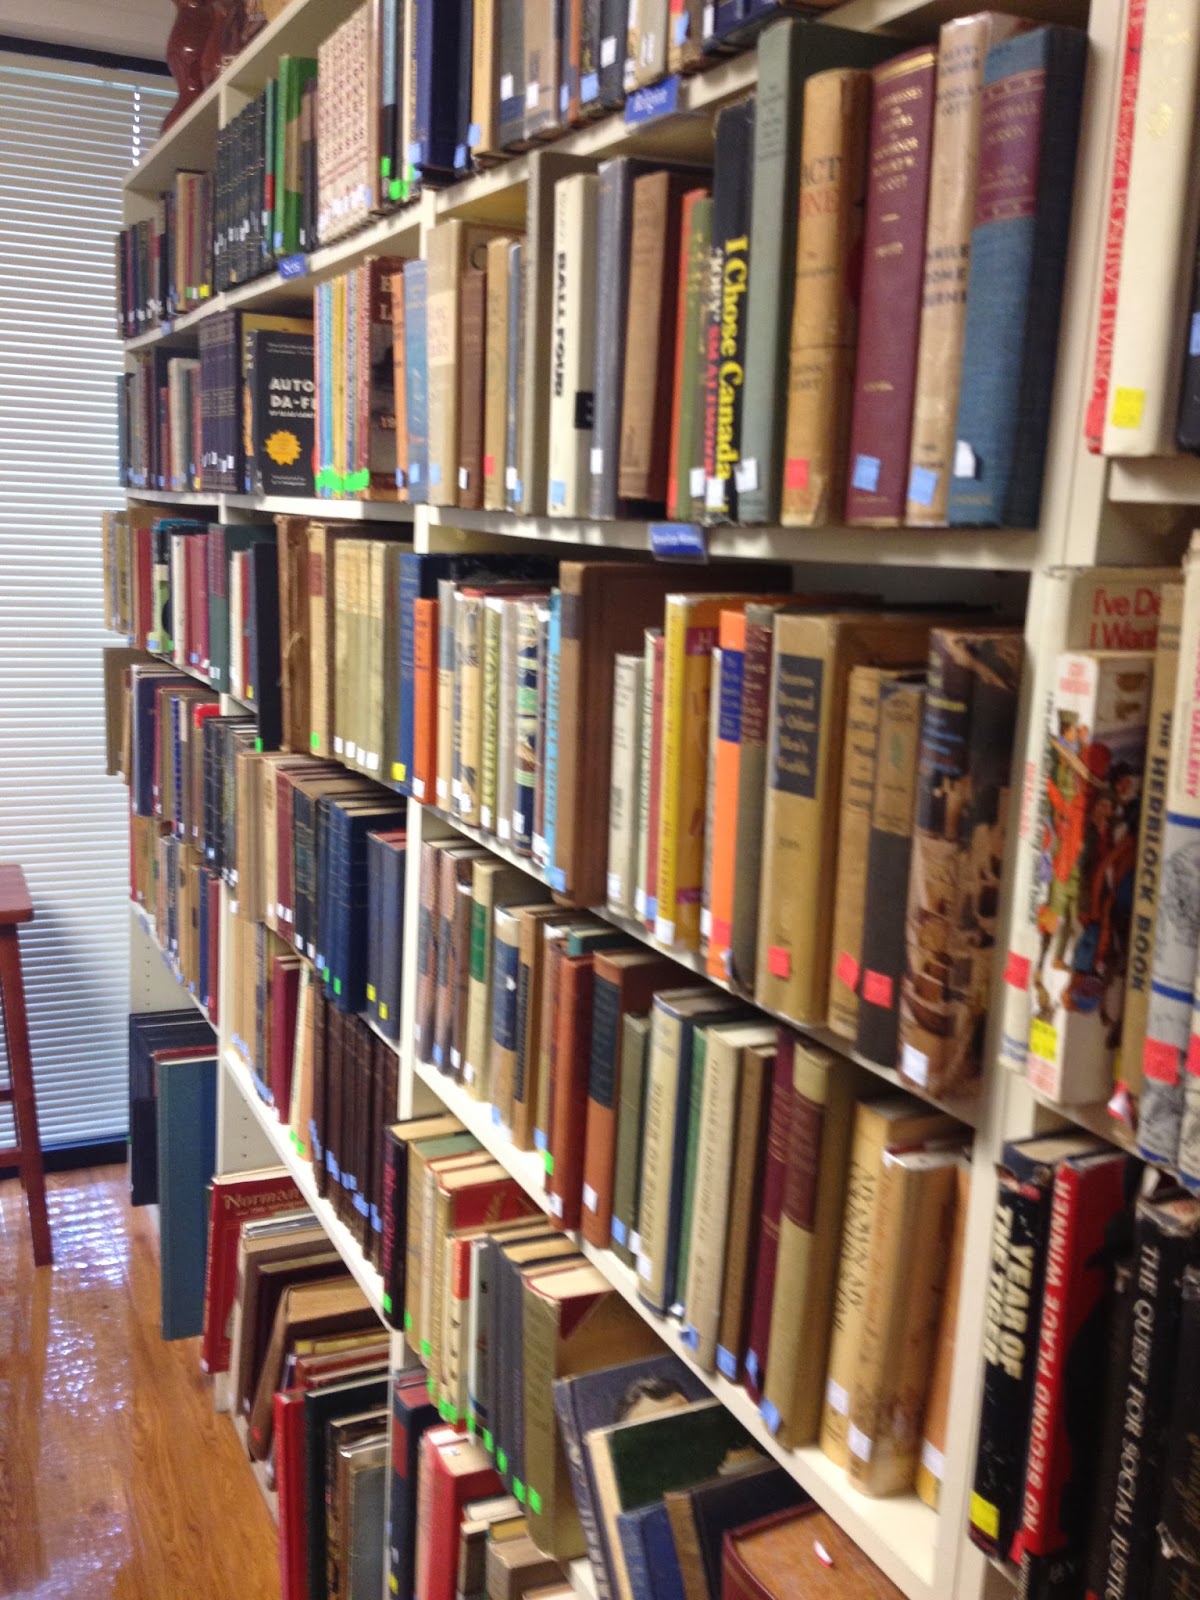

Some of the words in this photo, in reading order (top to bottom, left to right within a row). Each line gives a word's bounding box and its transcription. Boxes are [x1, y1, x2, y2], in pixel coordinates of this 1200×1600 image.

[725, 236, 747, 254] I
[720, 258, 746, 357] Chose
[269, 377, 315, 391] AUTO
[717, 361, 743, 480] Canada
[1159, 710, 1174, 748] THE
[1139, 756, 1168, 905] HERBLOCK
[1131, 912, 1152, 994] BOOK
[992, 1204, 1014, 1266] THE
[1046, 1175, 1072, 1288] WINNER
[1138, 1243, 1161, 1297] THE
[983, 1269, 1005, 1366] TIGER
[1002, 1244, 1036, 1333] YEAR
[999, 1332, 1026, 1380] OF
[1037, 1293, 1062, 1379] PLACE
[1130, 1298, 1156, 1384] QUEST
[1025, 1382, 1052, 1493] SECOND
[1124, 1383, 1147, 1439] FOR
[1023, 1493, 1042, 1533] NO
[1113, 1437, 1141, 1527] SOCIAL
